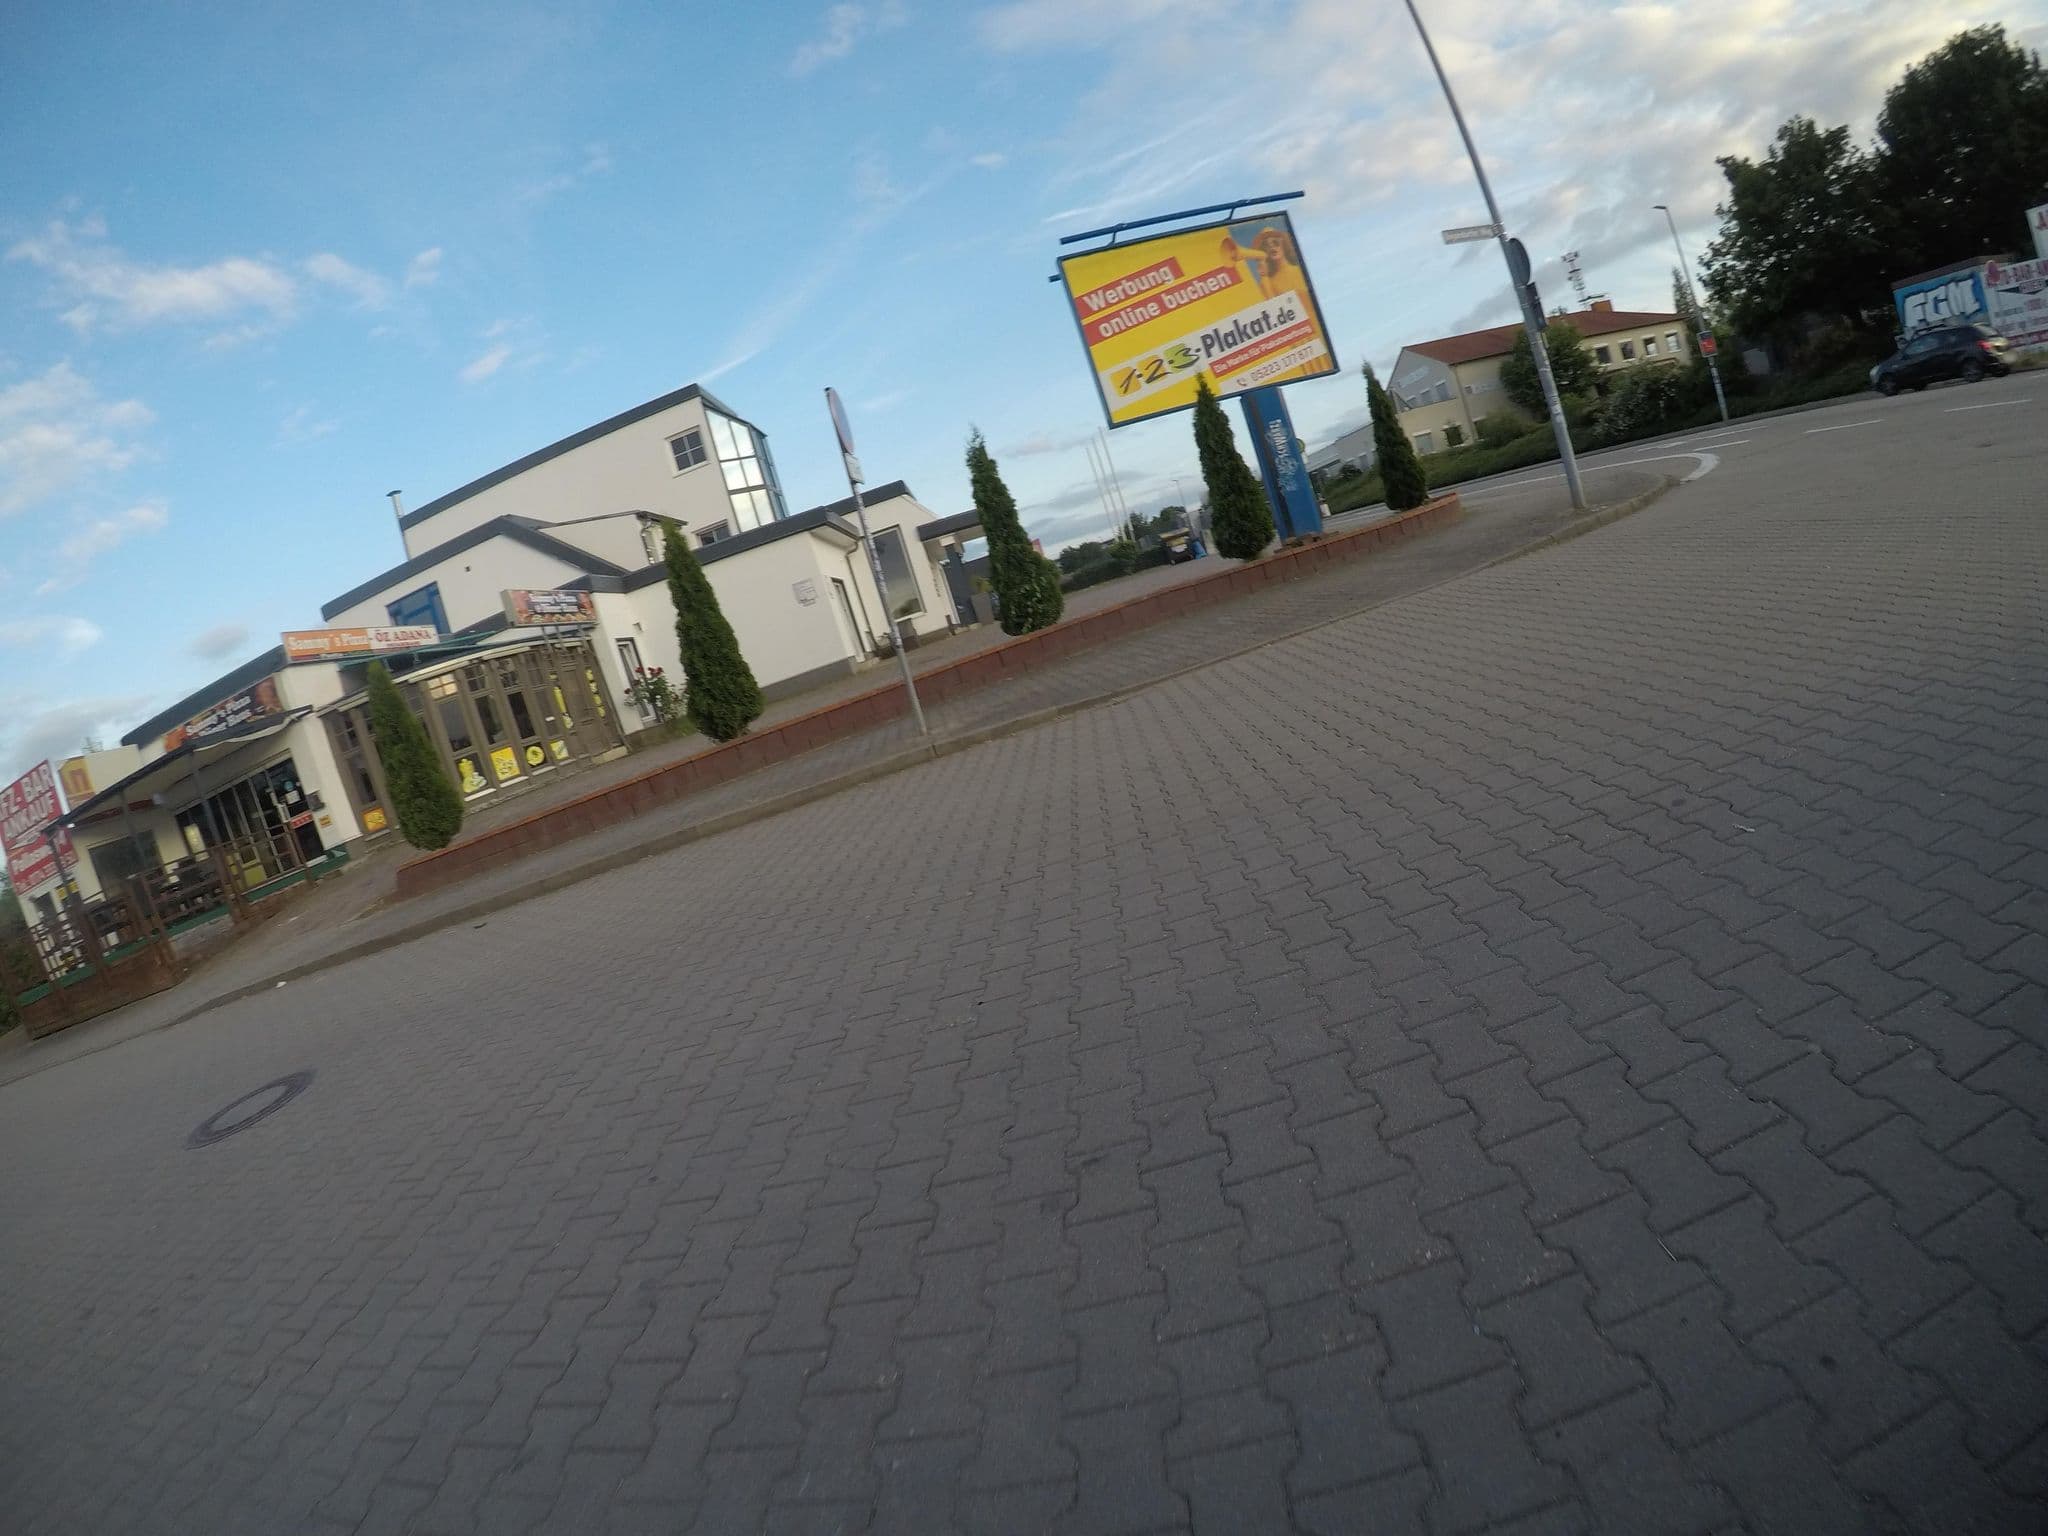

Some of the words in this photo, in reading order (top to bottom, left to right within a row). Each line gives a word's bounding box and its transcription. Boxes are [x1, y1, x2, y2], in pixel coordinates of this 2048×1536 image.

[1083, 265, 1174, 312] Werbung
[1099, 302, 1160, 338] online
[1163, 271, 1232, 307] buchen
[394, 629, 431, 641] ADANA
[4, 792, 54, 841] ANKAUF
